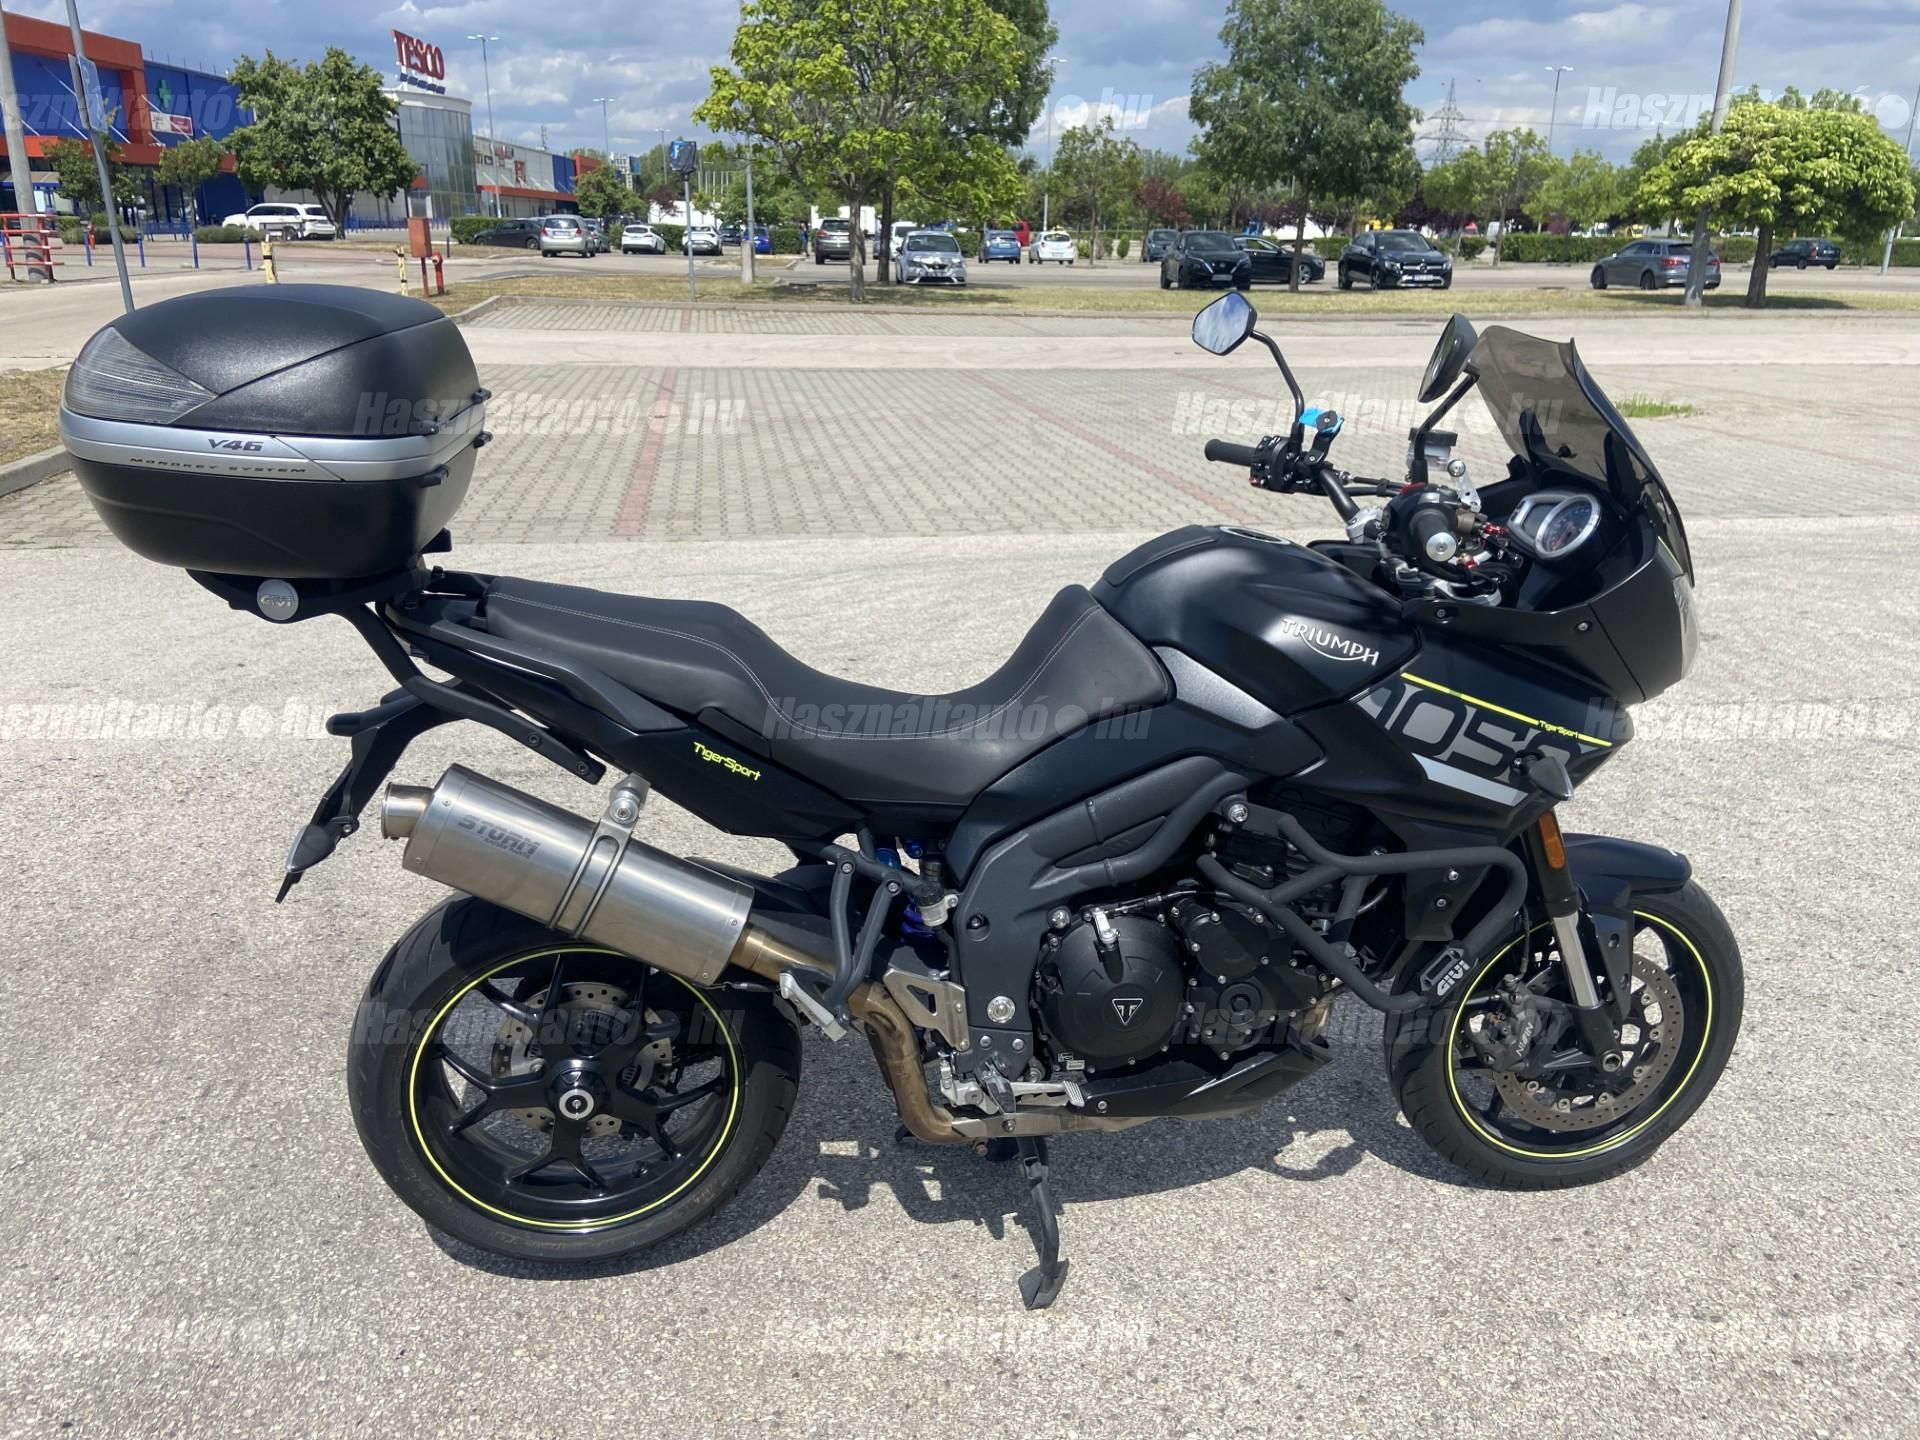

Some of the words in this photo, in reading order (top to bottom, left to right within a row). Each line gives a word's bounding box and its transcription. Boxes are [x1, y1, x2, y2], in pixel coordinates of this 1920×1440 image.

[392, 29, 445, 80] TESCO
[208, 438, 264, 451] V46
[228, 466, 306, 474] SYSTEM
[1282, 618, 1380, 666] TRIUMPH
[693, 741, 761, 781] TigerSport
[457, 814, 541, 856] STORM
[1437, 960, 1470, 996] GIVI
